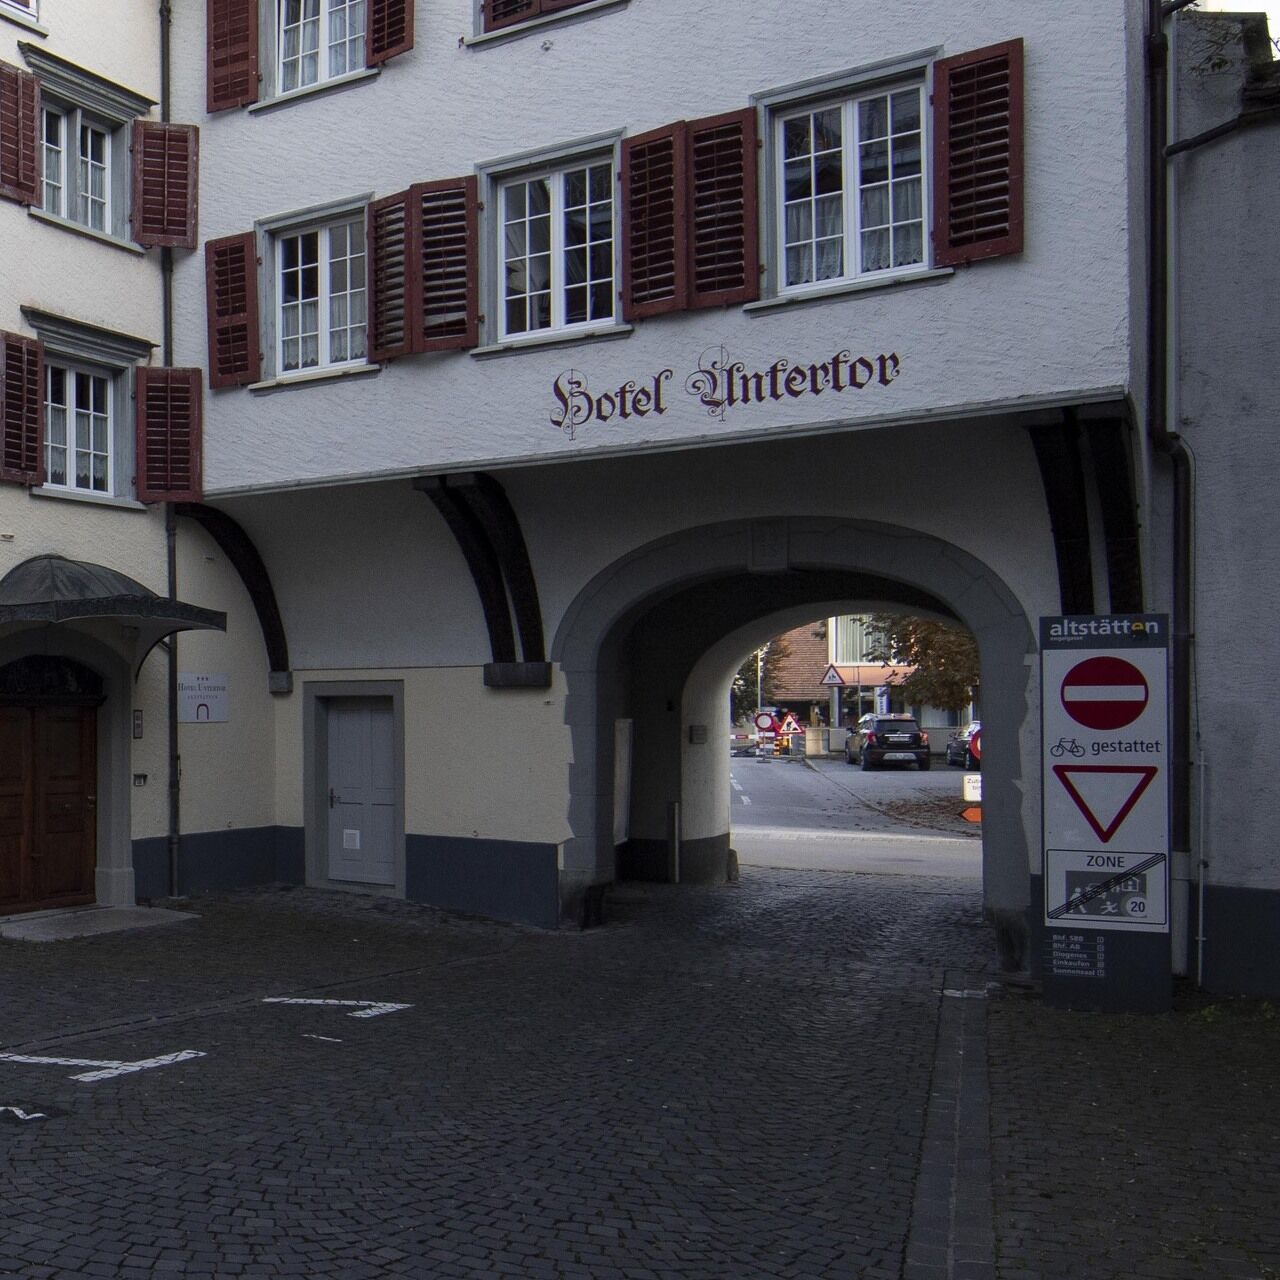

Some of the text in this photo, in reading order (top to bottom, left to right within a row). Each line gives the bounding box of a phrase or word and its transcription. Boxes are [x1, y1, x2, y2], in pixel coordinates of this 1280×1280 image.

[549, 343, 900, 440] Hotel Untertor
[1049, 619, 1160, 636] altstätten
[1091, 740, 1162, 756] gestattet
[1086, 855, 1126, 868] ZONE
[1130, 901, 1146, 913] 20
